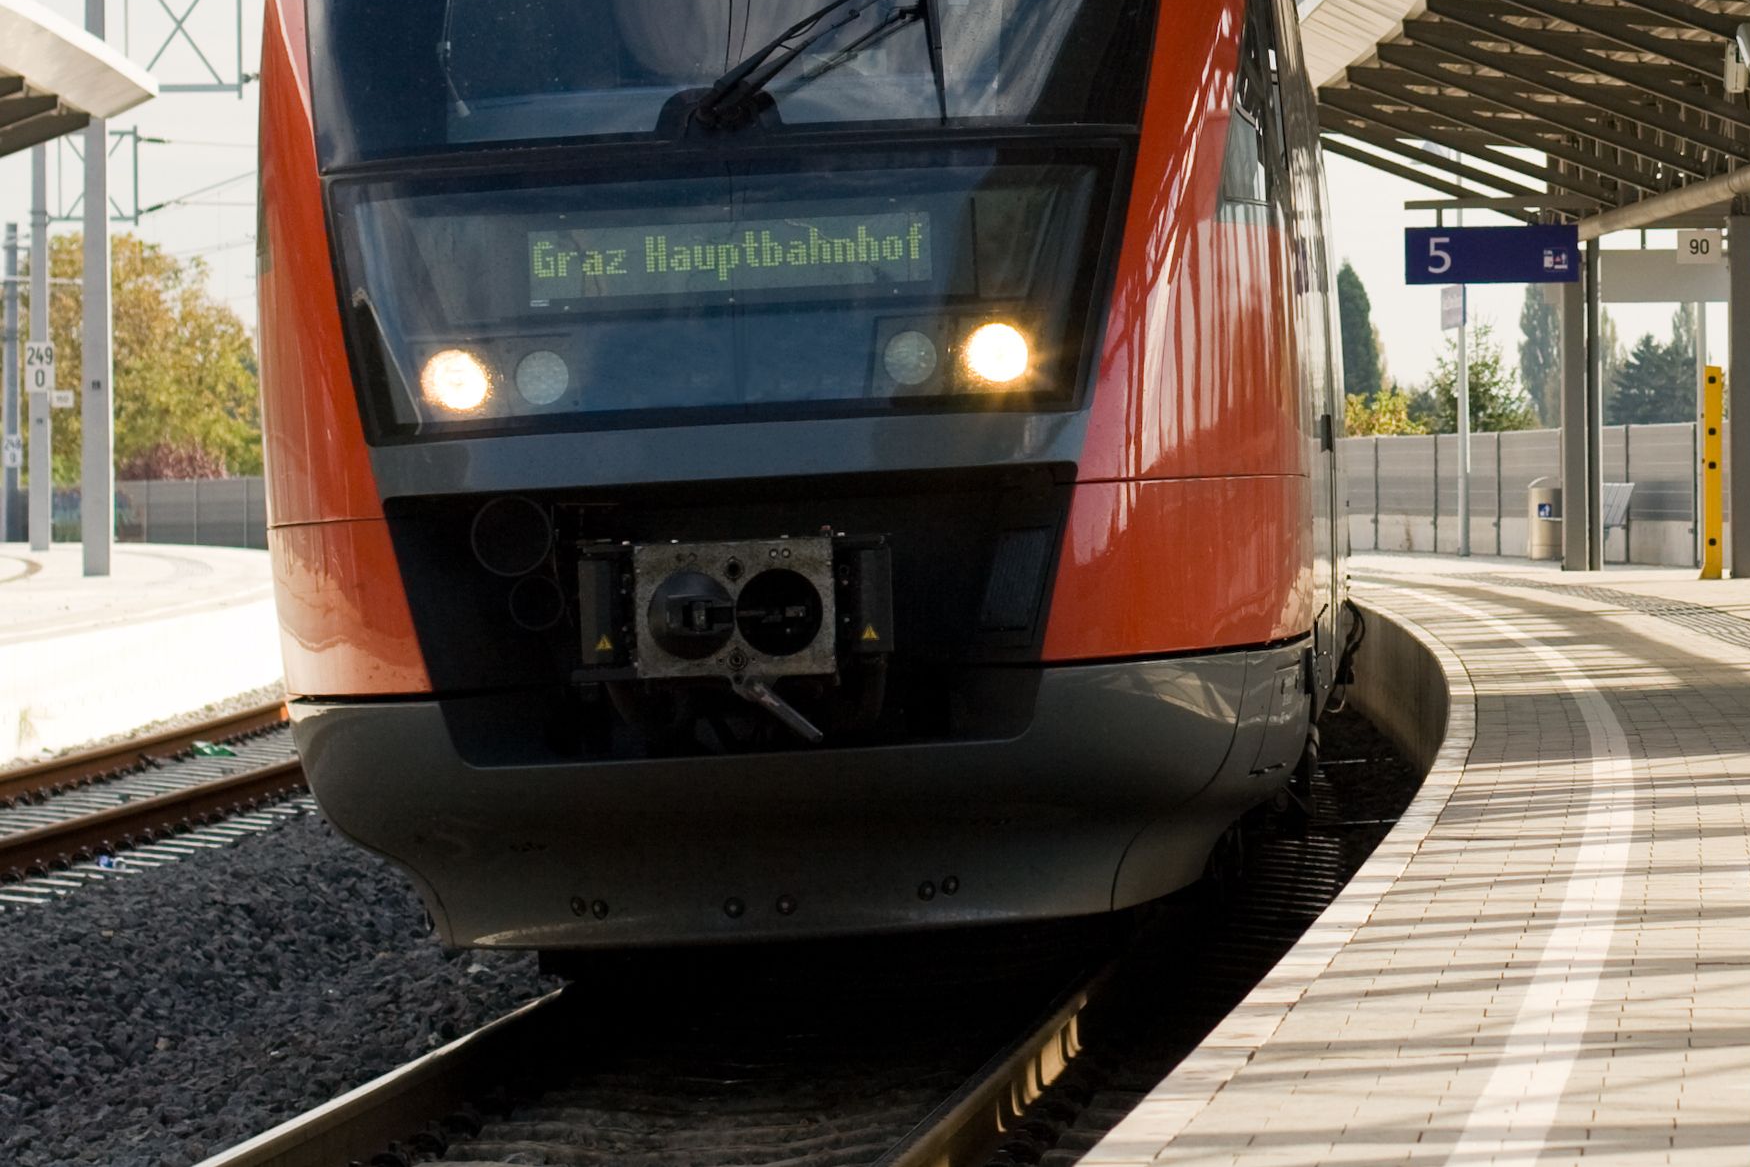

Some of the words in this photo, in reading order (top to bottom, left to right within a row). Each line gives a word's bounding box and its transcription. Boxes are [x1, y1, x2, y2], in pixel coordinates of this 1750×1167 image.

[532, 241, 628, 278] Graz
[645, 222, 923, 282] Hauptbahnhof
[1428, 237, 1451, 274] 5
[1689, 238, 1709, 255] 90
[27, 346, 53, 365] 249
[35, 369, 45, 388] 0
